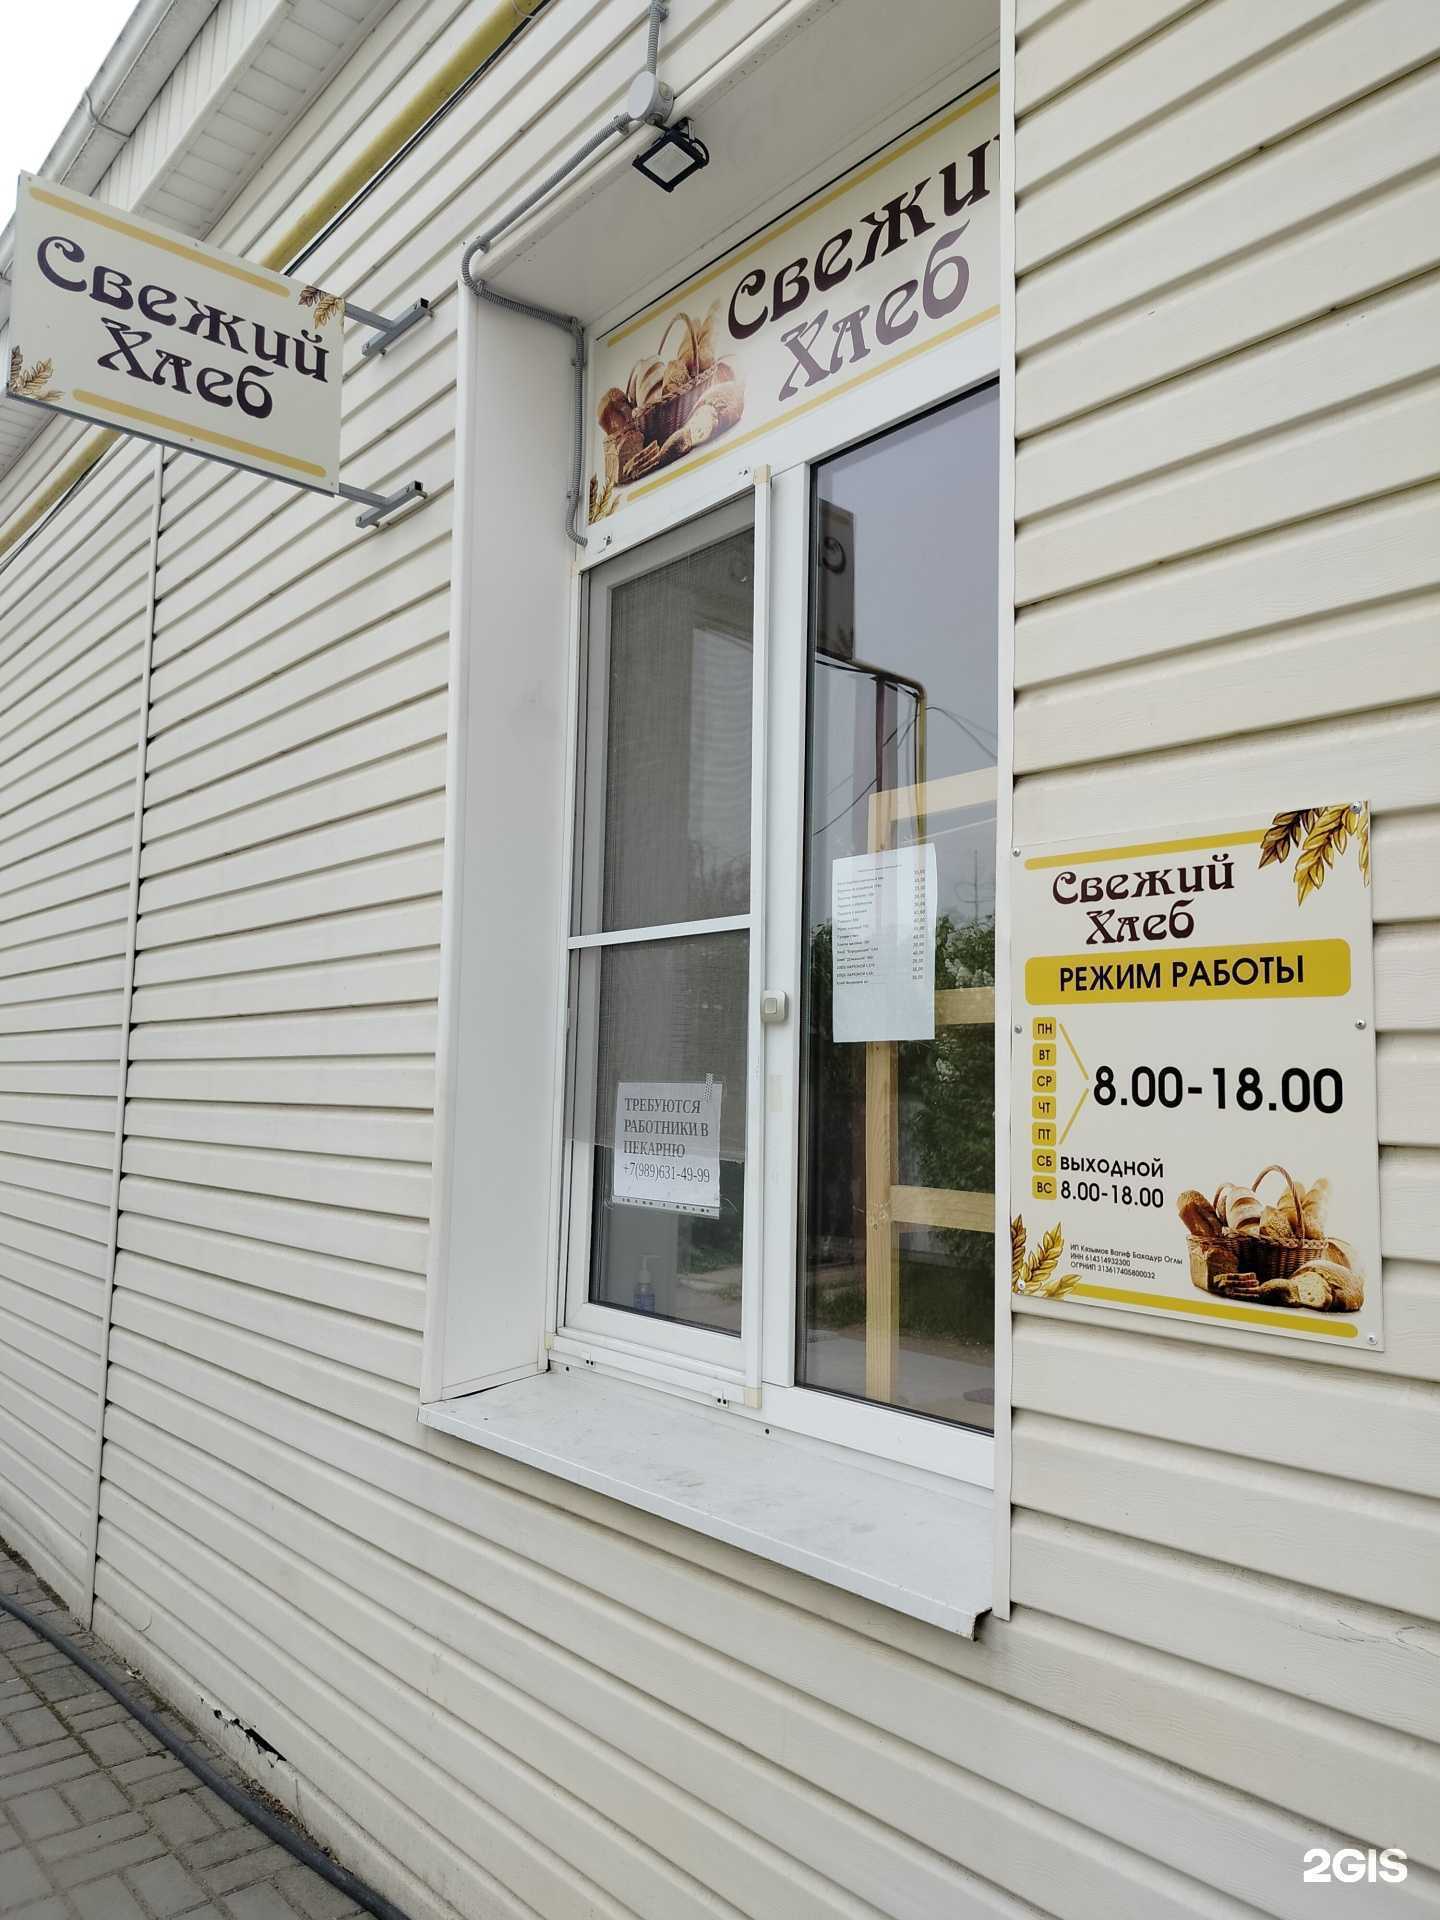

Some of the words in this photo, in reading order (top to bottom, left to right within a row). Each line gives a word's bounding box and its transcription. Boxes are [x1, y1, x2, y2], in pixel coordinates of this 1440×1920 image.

[728, 134, 1000, 339] Свежи
[37, 235, 330, 383] Свежий
[778, 217, 971, 401] Хлеб
[97, 317, 275, 419] Хлеб
[1052, 853, 1235, 905] Свежий
[1085, 899, 1195, 945] Хлеб
[1059, 962, 1162, 992] РЕЖИМ
[1172, 955, 1305, 988] РАБОТЫ
[1037, 1023, 1053, 1035] ПН
[1039, 1049, 1051, 1061] ВТ
[1036, 1075, 1053, 1087] СР
[1093, 1065, 1344, 1114] 8.00-18.00
[624, 1097, 701, 1114] ТРЕБУЮТСЯ
[1038, 1101, 1051, 1113] ЧТ
[624, 1119, 700, 1136] РАБОТНИКИ
[701, 1122, 709, 1137] В
[1038, 1128, 1051, 1141] ПТ
[623, 1140, 686, 1158] ПЕКАРНЮ
[624, 1162, 710, 1184] +7(989)631-49-99
[1036, 1155, 1053, 1167] СБ
[1060, 1156, 1164, 1179] ВЫХОДНОЙ
[1036, 1181, 1053, 1194] ВС
[1060, 1180, 1164, 1208] 8.00-18.00
[1070, 1244, 1080, 1252] ИП
[1070, 1252, 1084, 1260] ИНН
